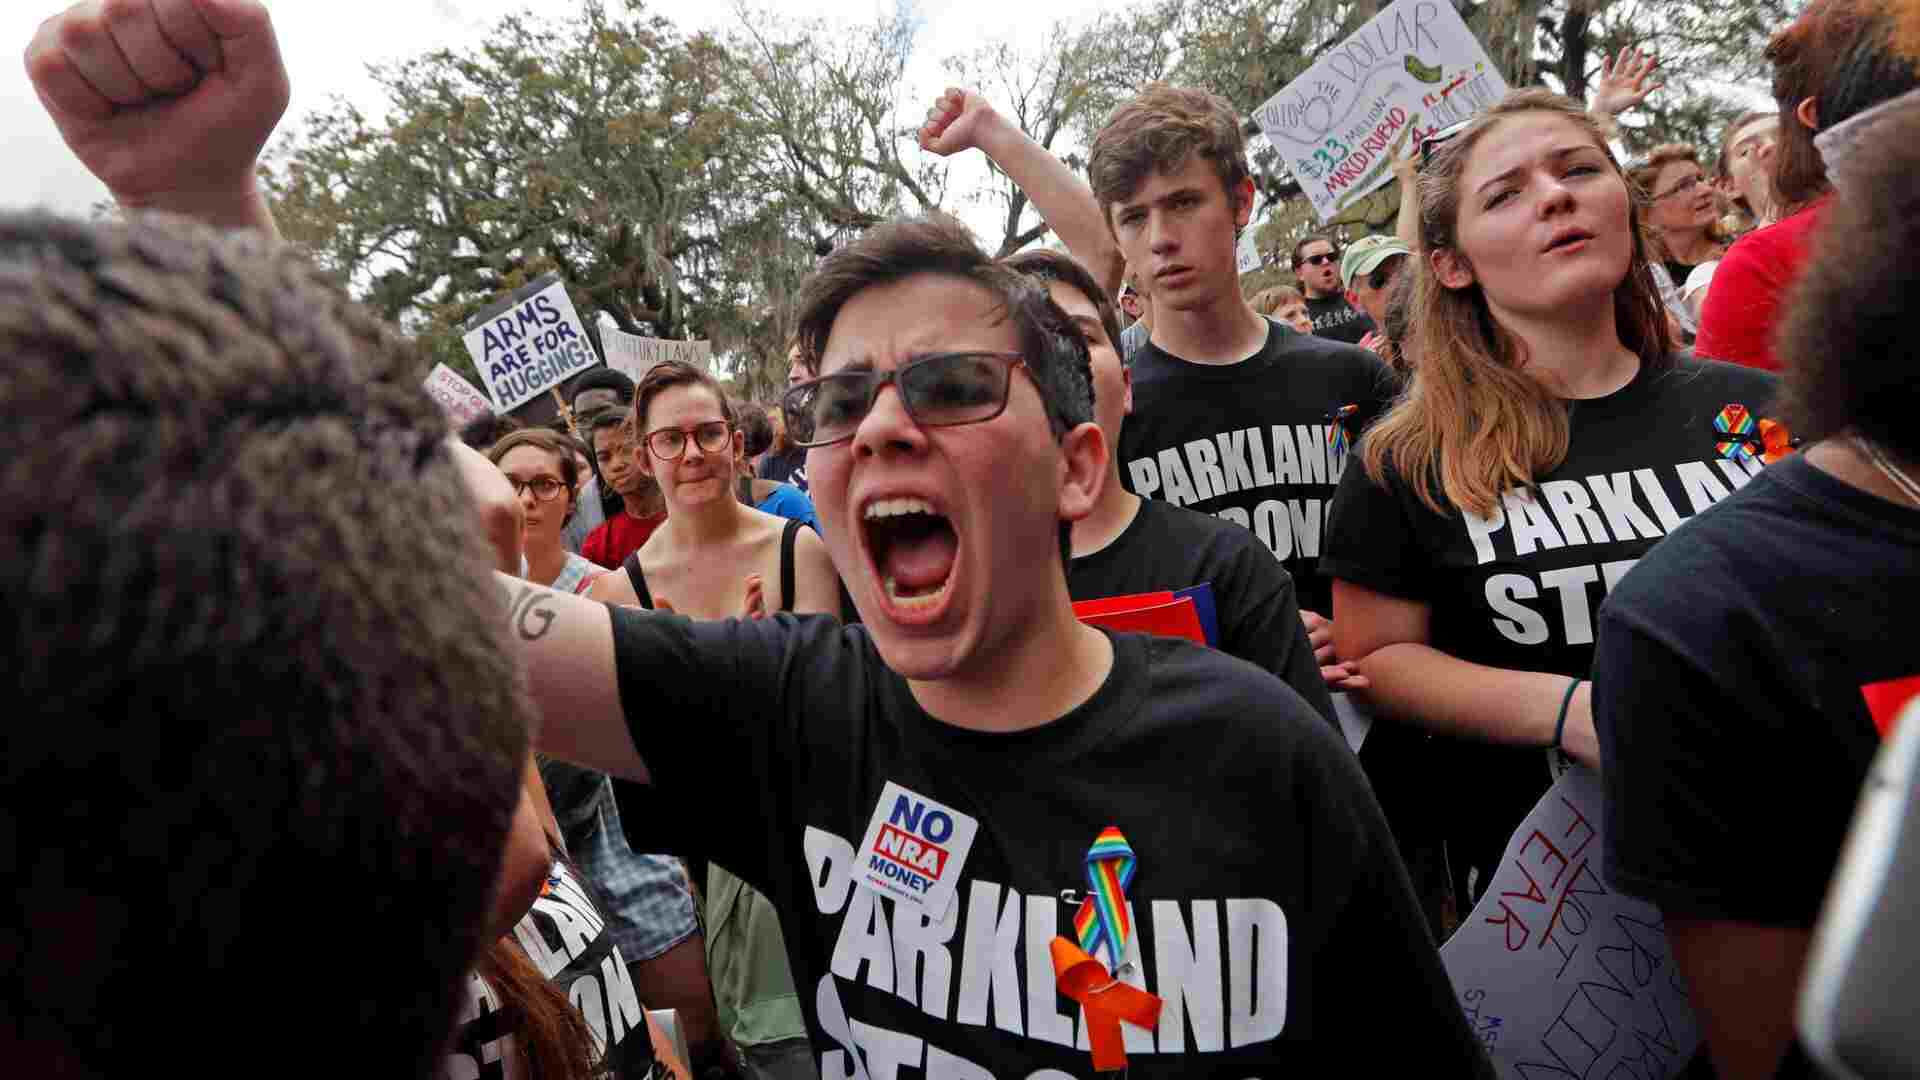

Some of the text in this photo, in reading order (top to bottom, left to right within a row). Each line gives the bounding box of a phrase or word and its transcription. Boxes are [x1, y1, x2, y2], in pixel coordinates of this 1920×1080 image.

[1329, 2, 1439, 83] DOLLAR
[481, 295, 561, 361] ARMS
[490, 320, 577, 381] ARE FOR
[494, 337, 596, 407] HUGGING!
[889, 794, 953, 844] NO
[869, 855, 934, 894] MONEY
[880, 830, 940, 876] NRA
[1485, 796, 1596, 951] FEAR
[1549, 857, 1608, 980] NOT
